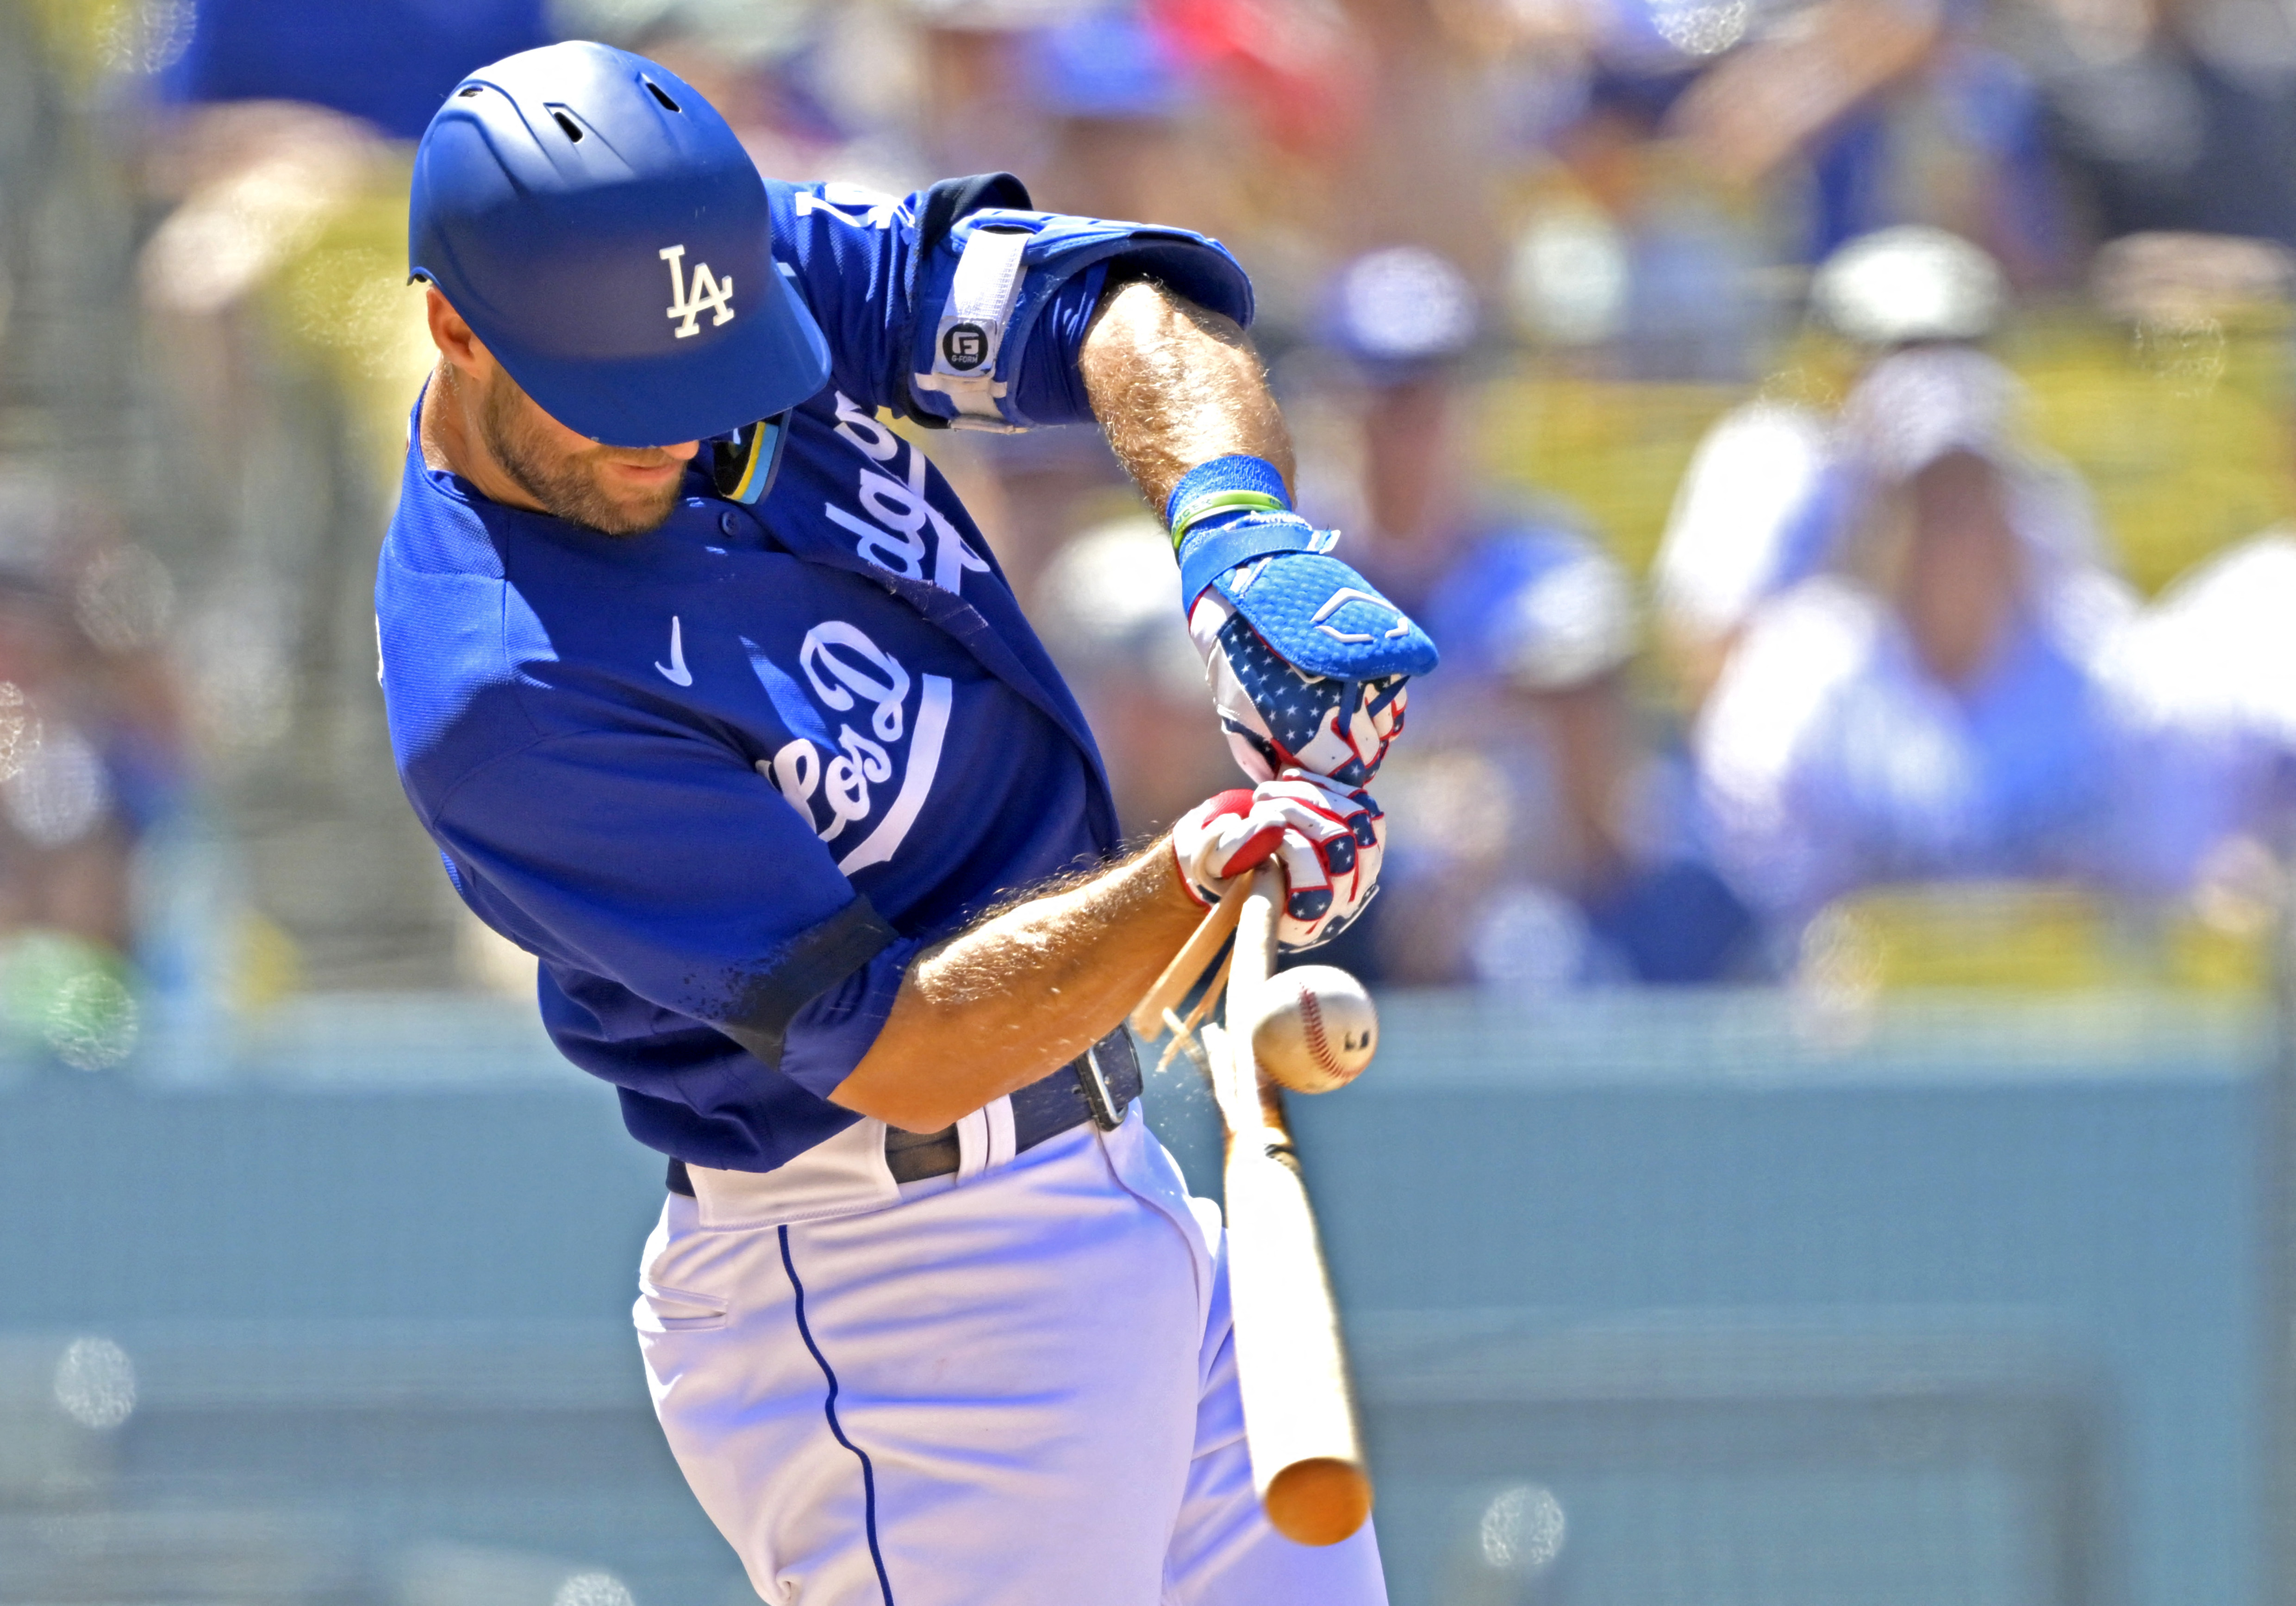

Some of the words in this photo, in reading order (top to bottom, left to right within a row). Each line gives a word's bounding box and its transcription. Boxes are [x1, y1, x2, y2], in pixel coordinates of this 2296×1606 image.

[659, 244, 734, 338] LA
[951, 355, 978, 363] G-FORM
[755, 729, 892, 843] Los
